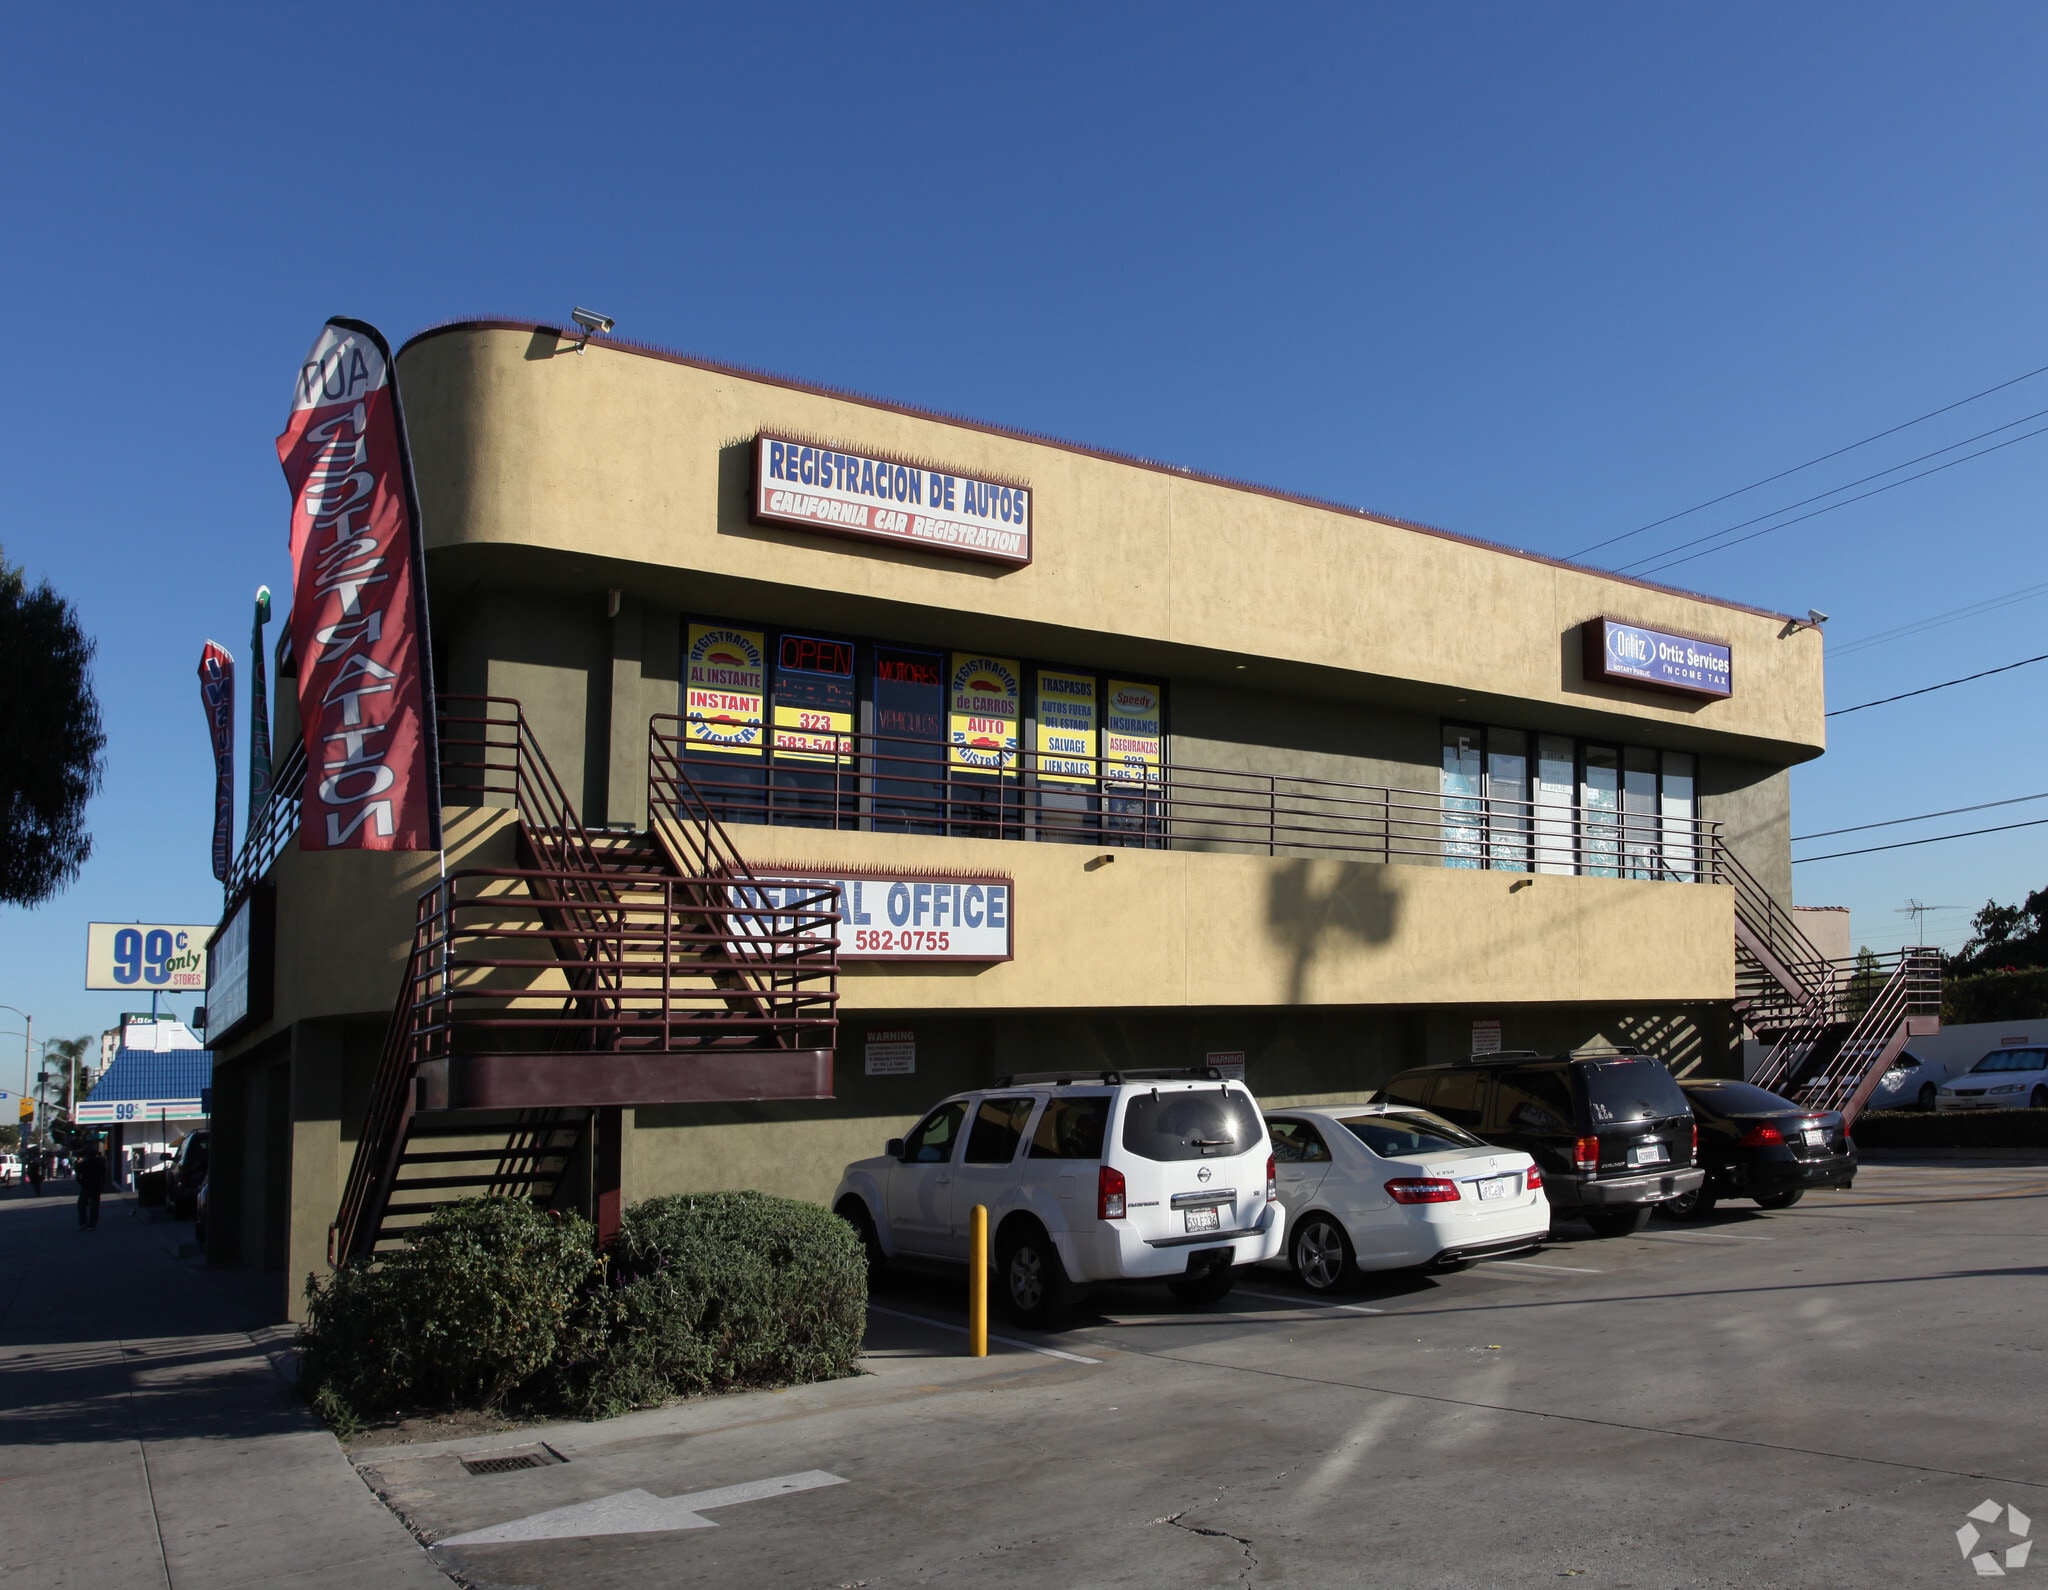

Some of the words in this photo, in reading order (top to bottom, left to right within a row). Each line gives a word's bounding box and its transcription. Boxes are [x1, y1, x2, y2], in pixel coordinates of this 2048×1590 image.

[769, 441, 922, 505] REGISTRACION
[929, 472, 955, 511] DE
[964, 480, 1024, 525] AUTOS
[770, 491, 869, 527] CALIFORNIA
[874, 509, 908, 533] CAR
[912, 516, 1021, 553] REGISTRATION
[690, 631, 762, 668] REGISTRACIÓN
[781, 638, 851, 675] OPEN
[1618, 631, 1646, 661] Ortiz
[1659, 643, 1684, 664] Ortiz
[1687, 648, 1729, 674] Services
[691, 667, 704, 682] AL
[707, 668, 761, 688] INSTANTE
[879, 660, 939, 686] MOTORES
[952, 658, 1018, 697] REGISTRACIÓN
[1614, 664, 1633, 674] NOTARY
[1633, 667, 1651, 677] PUBLIC
[1662, 665, 1702, 681] INCOME
[1708, 674, 1726, 685] TAX
[1042, 678, 1092, 696] TRASPASOS
[690, 691, 760, 712] INSTANT
[956, 695, 970, 710] de
[973, 696, 1015, 715] CARROS
[1042, 701, 1067, 714] AUTOS
[1069, 703, 1092, 717] FUERA
[1117, 692, 1151, 709] Speedy
[800, 713, 831, 731] 323
[968, 717, 1004, 735] AUTO
[1045, 717, 1059, 728] DEL
[1060, 718, 1089, 731] ESTADO
[1110, 716, 1158, 734] INSURANCE
[1048, 737, 1085, 753] SALVAGE
[1110, 738, 1158, 755] ASEGURANZAS
[1044, 760, 1062, 773] LIEN
[1064, 763, 1090, 776] SALES
[887, 881, 1006, 929] OFFICE
[856, 930, 950, 952] 582-0755
[165, 949, 201, 973] only
[173, 973, 201, 986] STORES
[867, 1030, 915, 1042] WARNING
[1209, 1054, 1243, 1065] WARNING
